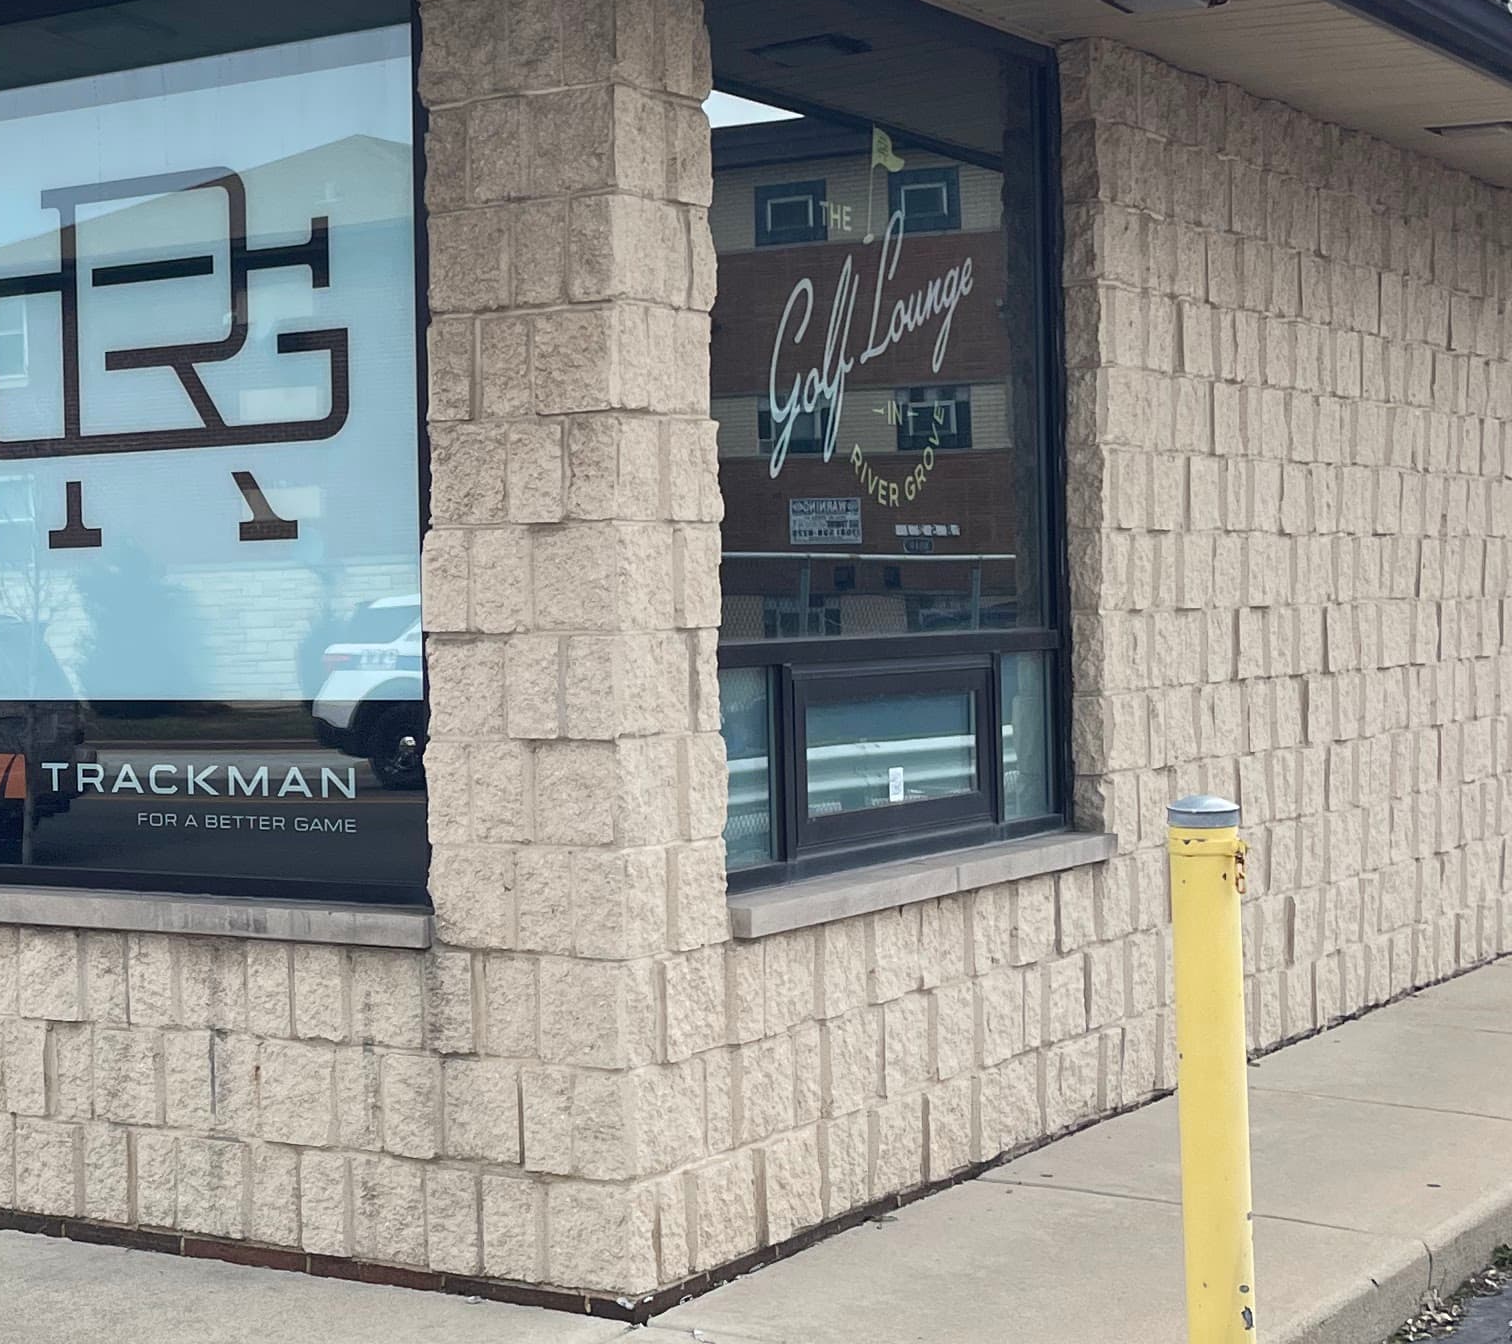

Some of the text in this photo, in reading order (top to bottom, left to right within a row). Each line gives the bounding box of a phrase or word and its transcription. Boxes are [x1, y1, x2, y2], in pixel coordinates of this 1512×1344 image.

[818, 200, 853, 232] THE
[769, 209, 974, 479] Golf Lounge
[850, 400, 945, 507] RIVER GROVE
[41, 762, 357, 800] TRACKMAN
[137, 812, 357, 833] FOR A BETTER GAME
